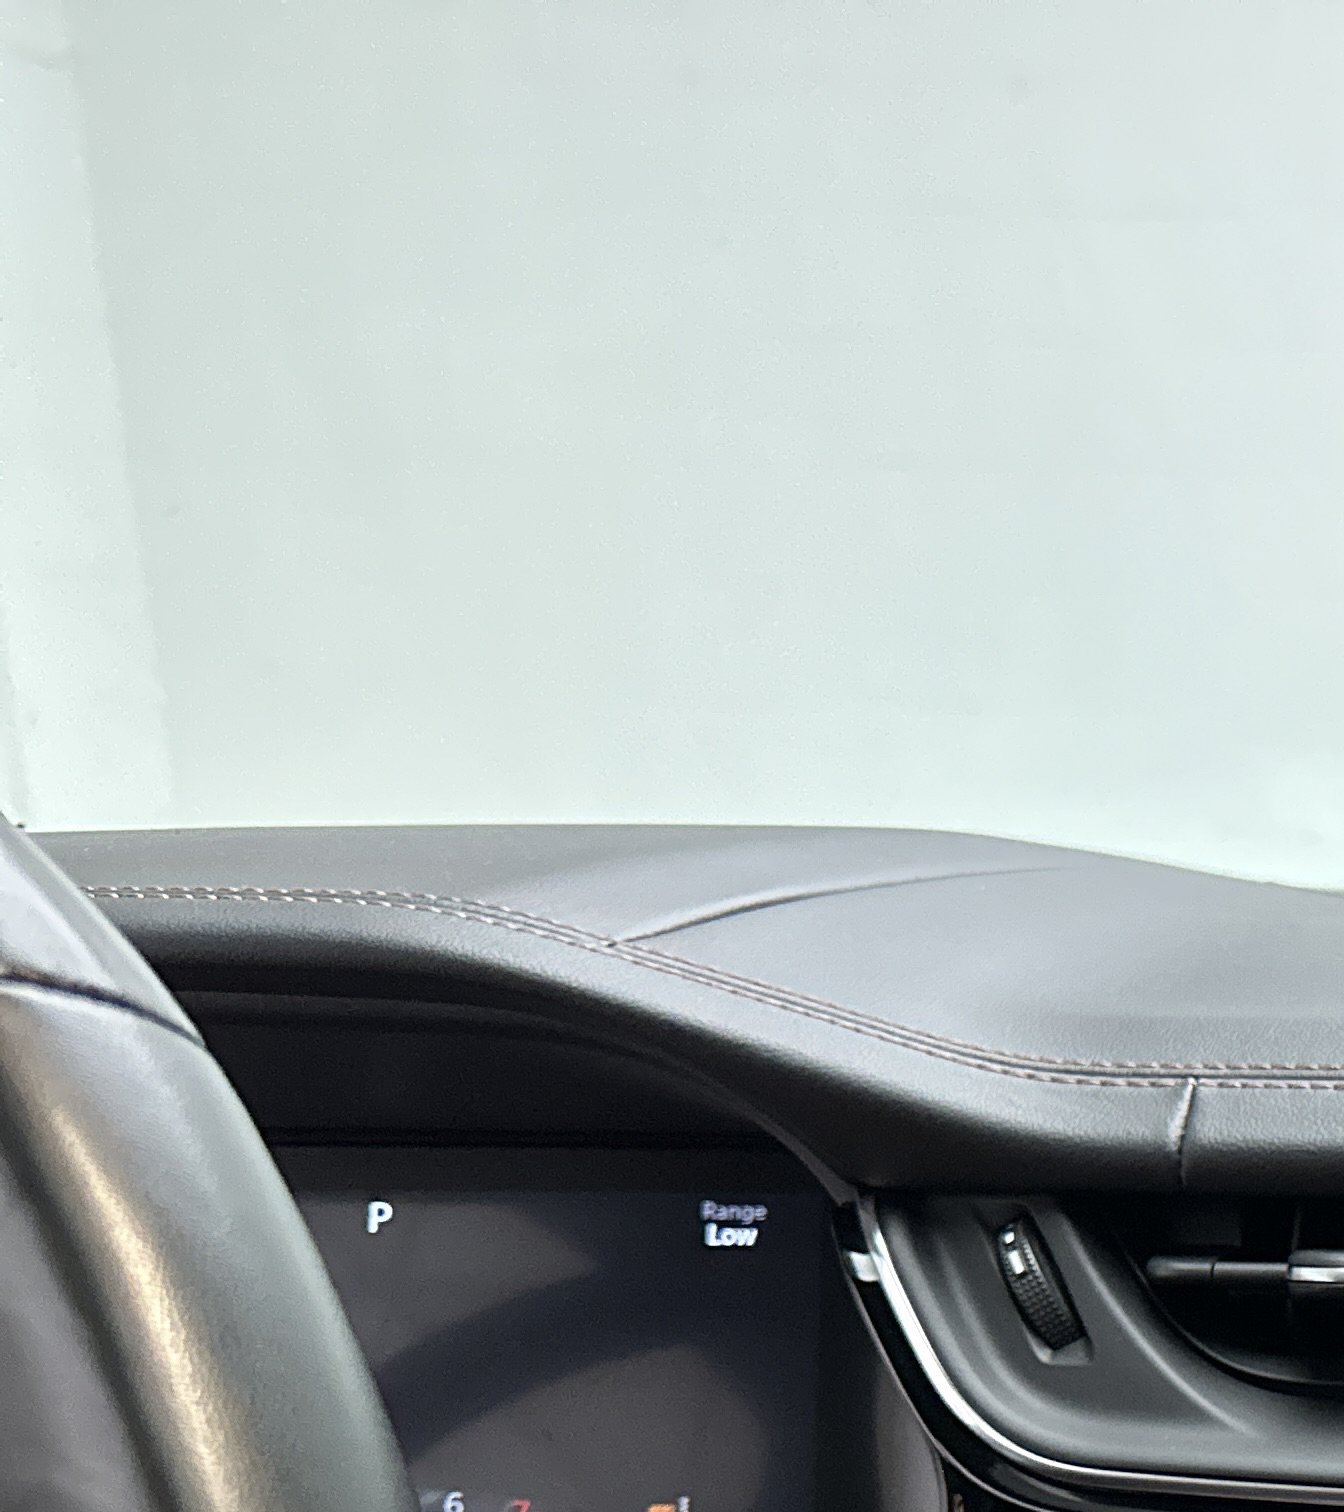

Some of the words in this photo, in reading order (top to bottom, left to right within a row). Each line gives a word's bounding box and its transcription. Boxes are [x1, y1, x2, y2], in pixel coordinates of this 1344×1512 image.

[367, 1201, 394, 1234] P
[702, 1199, 768, 1225] Range
[704, 1222, 759, 1247] Low
